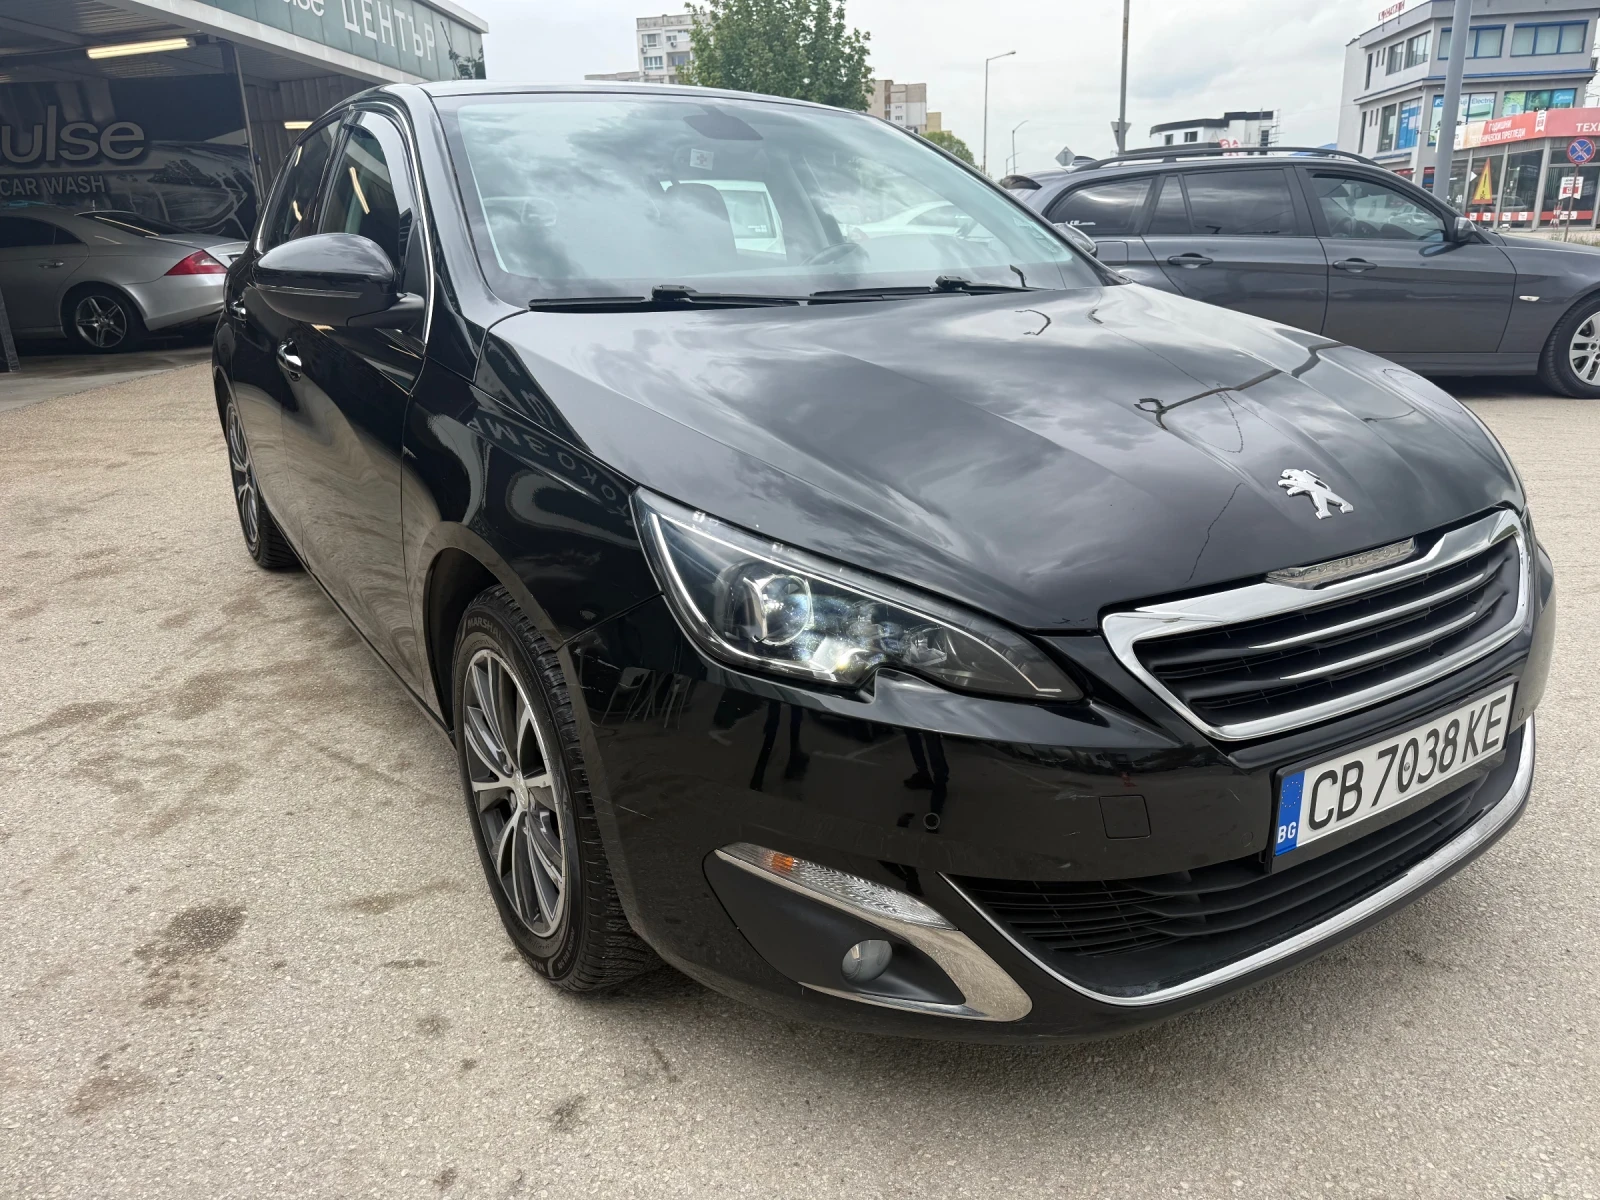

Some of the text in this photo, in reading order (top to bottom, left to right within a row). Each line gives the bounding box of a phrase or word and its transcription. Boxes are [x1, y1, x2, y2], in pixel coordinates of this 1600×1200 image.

[341, 0, 436, 61] ЦЕНТЪР
[0, 175, 106, 196] CAR WASH
[1307, 694, 1507, 831] CB 7038 KE
[1277, 821, 1298, 845] BG
